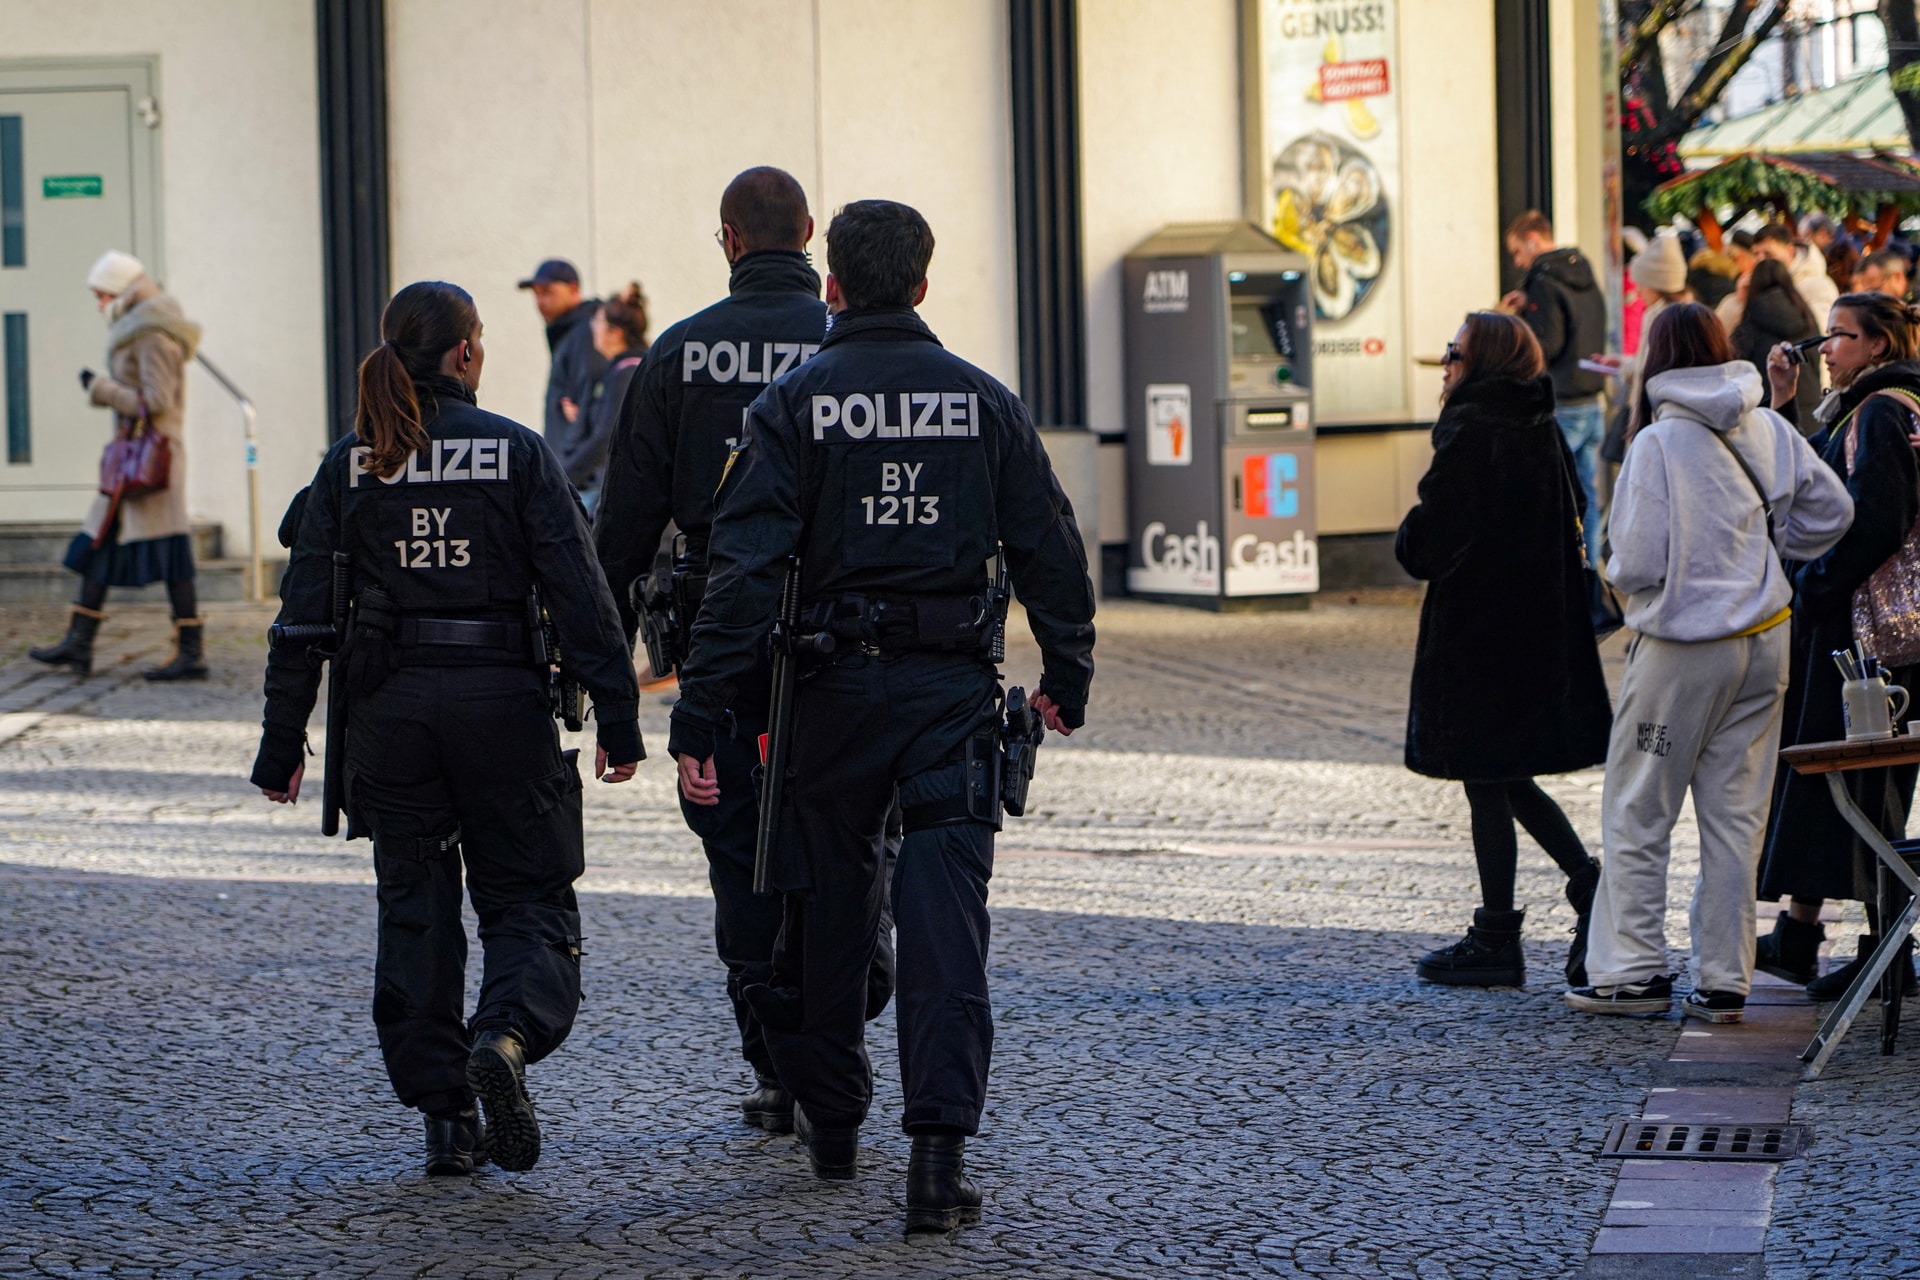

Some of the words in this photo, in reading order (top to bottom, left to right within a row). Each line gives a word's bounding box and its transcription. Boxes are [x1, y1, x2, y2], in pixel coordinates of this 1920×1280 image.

[1281, 4, 1385, 38] GENUSS!
[1143, 269, 1189, 299] ATM
[683, 341, 820, 383] POLIZ
[812, 393, 980, 440] POLIZEI
[881, 462, 924, 492] BY
[411, 508, 452, 537] BY
[861, 496, 940, 525] 1213
[394, 540, 471, 568] 1213
[1142, 520, 1220, 573] Cash
[1231, 530, 1318, 570] Cash
